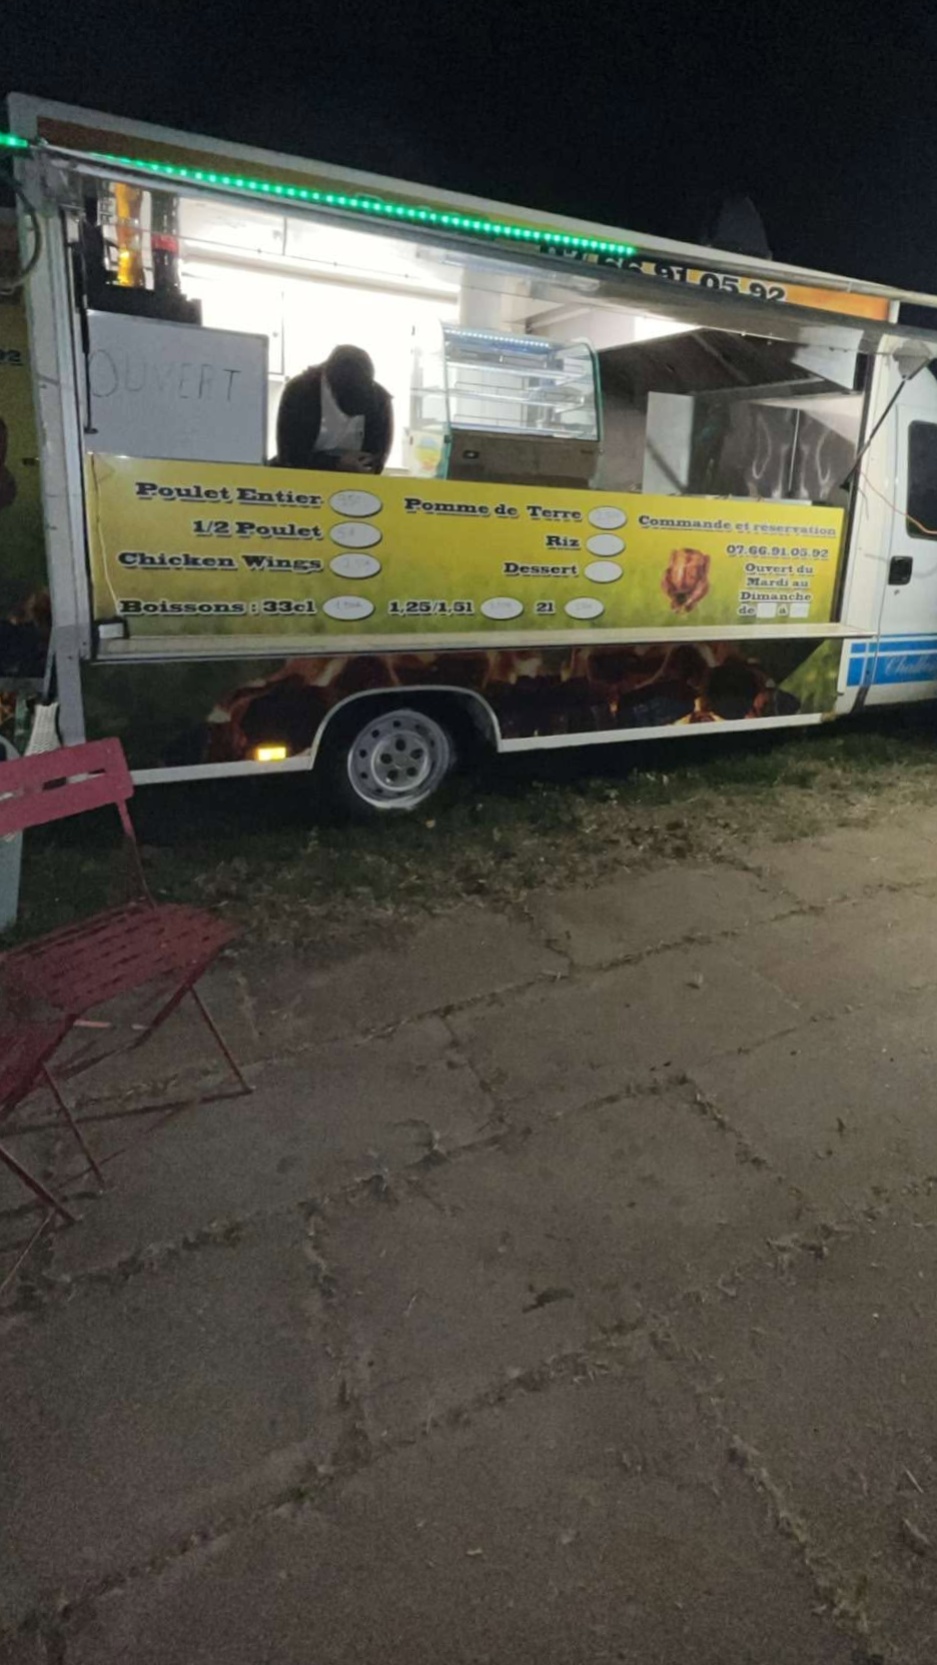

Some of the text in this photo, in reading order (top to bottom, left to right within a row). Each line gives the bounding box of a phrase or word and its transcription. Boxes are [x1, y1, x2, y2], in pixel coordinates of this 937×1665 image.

[136, 482, 231, 500] Poulet
[237, 487, 322, 505] Entier
[404, 498, 490, 514] Pomme
[494, 504, 518, 516] de
[526, 505, 582, 519] Terre
[193, 520, 230, 534] 1/2
[235, 521, 322, 538] Poulet
[638, 514, 732, 530] Commande
[735, 522, 750, 532] et
[546, 535, 580, 547] Riz
[118, 552, 322, 572] Chicken Wings
[503, 562, 578, 575] Dessert
[745, 563, 813, 574] Ouvert du
[746, 577, 809, 588] Mardi au
[741, 591, 812, 601] Dimanche
[119, 599, 245, 614] Boissons
